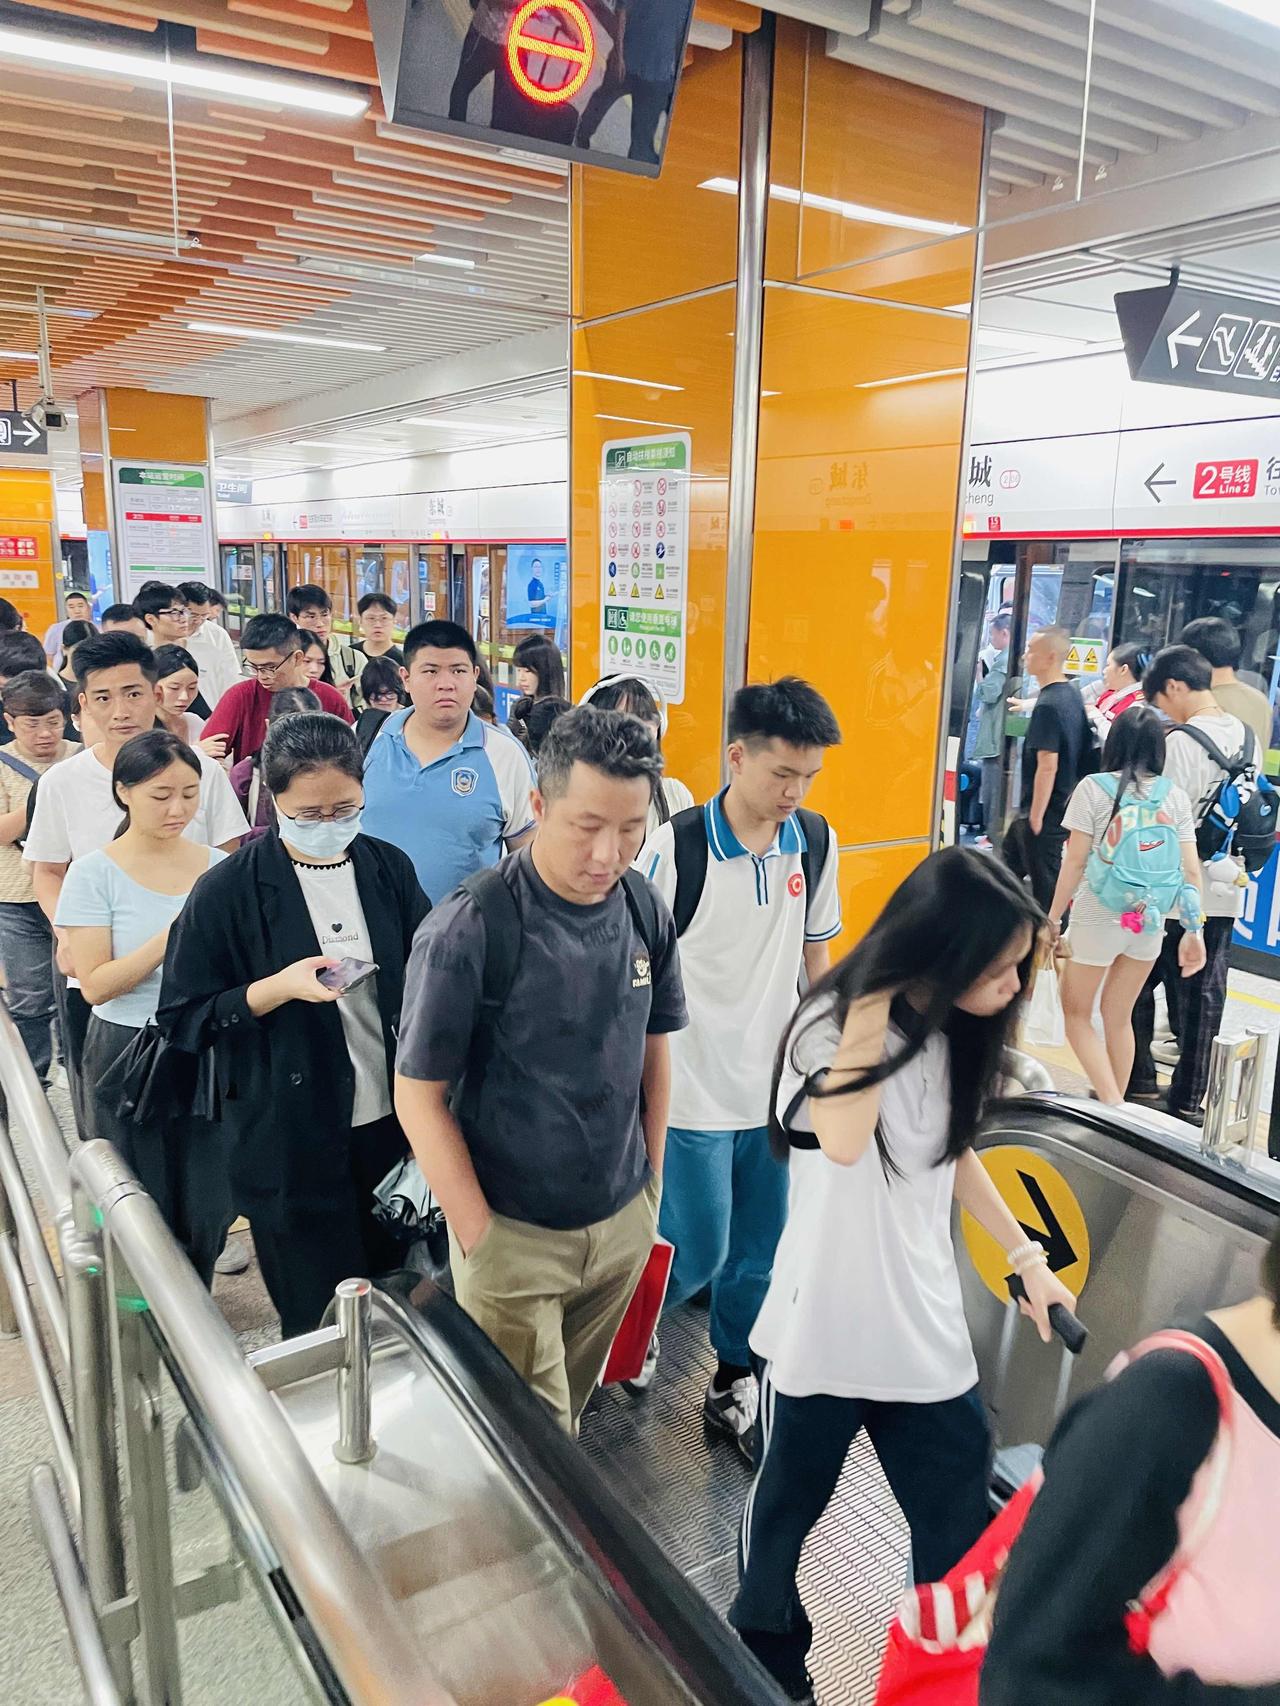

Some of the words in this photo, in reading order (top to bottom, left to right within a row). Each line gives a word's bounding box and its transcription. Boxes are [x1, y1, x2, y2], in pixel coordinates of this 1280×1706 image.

[217, 482, 248, 494] 卫生间
[1219, 485, 1241, 494] Line
[1243, 484, 1249, 493] 2
